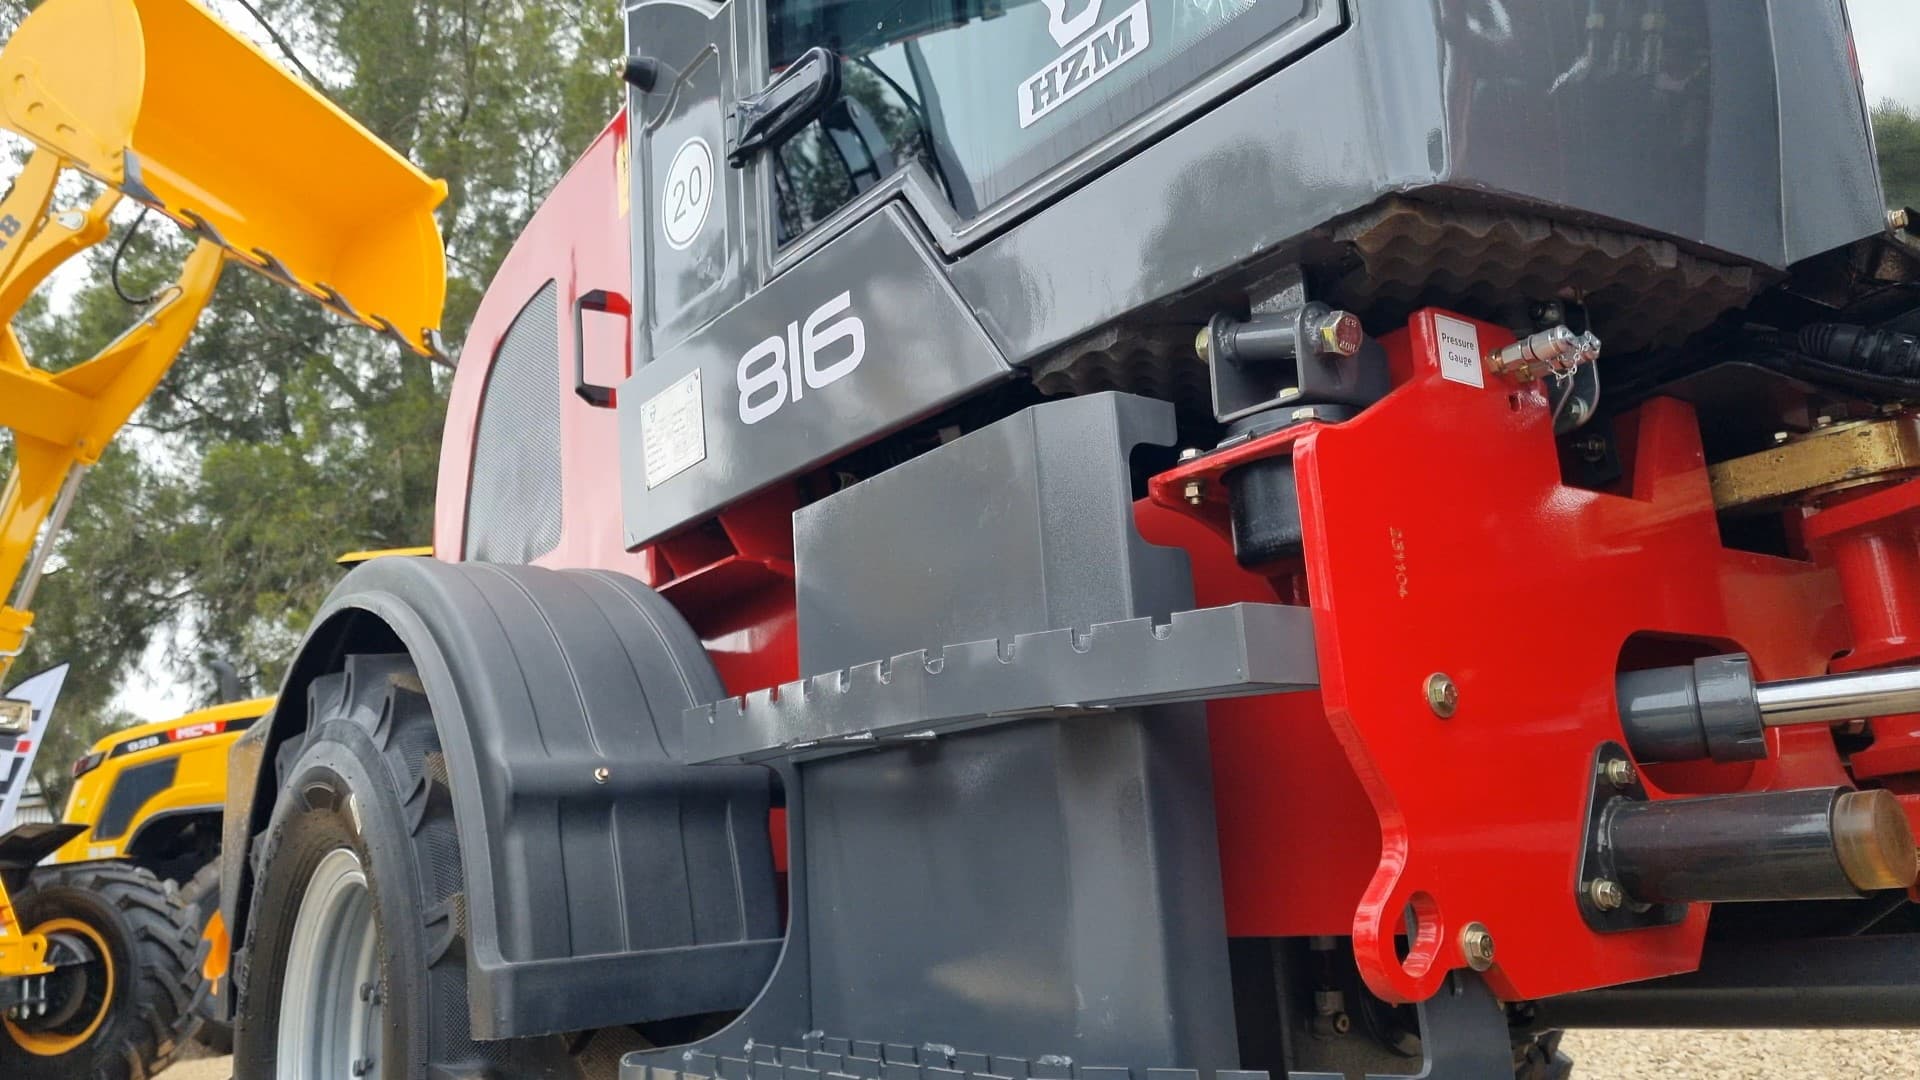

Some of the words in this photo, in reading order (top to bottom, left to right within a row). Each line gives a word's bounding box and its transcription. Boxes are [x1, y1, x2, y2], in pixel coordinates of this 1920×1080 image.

[1029, 14, 1135, 115] HZM
[673, 166, 702, 224] 20
[737, 289, 866, 425] 816
[1441, 332, 1475, 350] Pressure
[1448, 351, 1473, 367] Gauge
